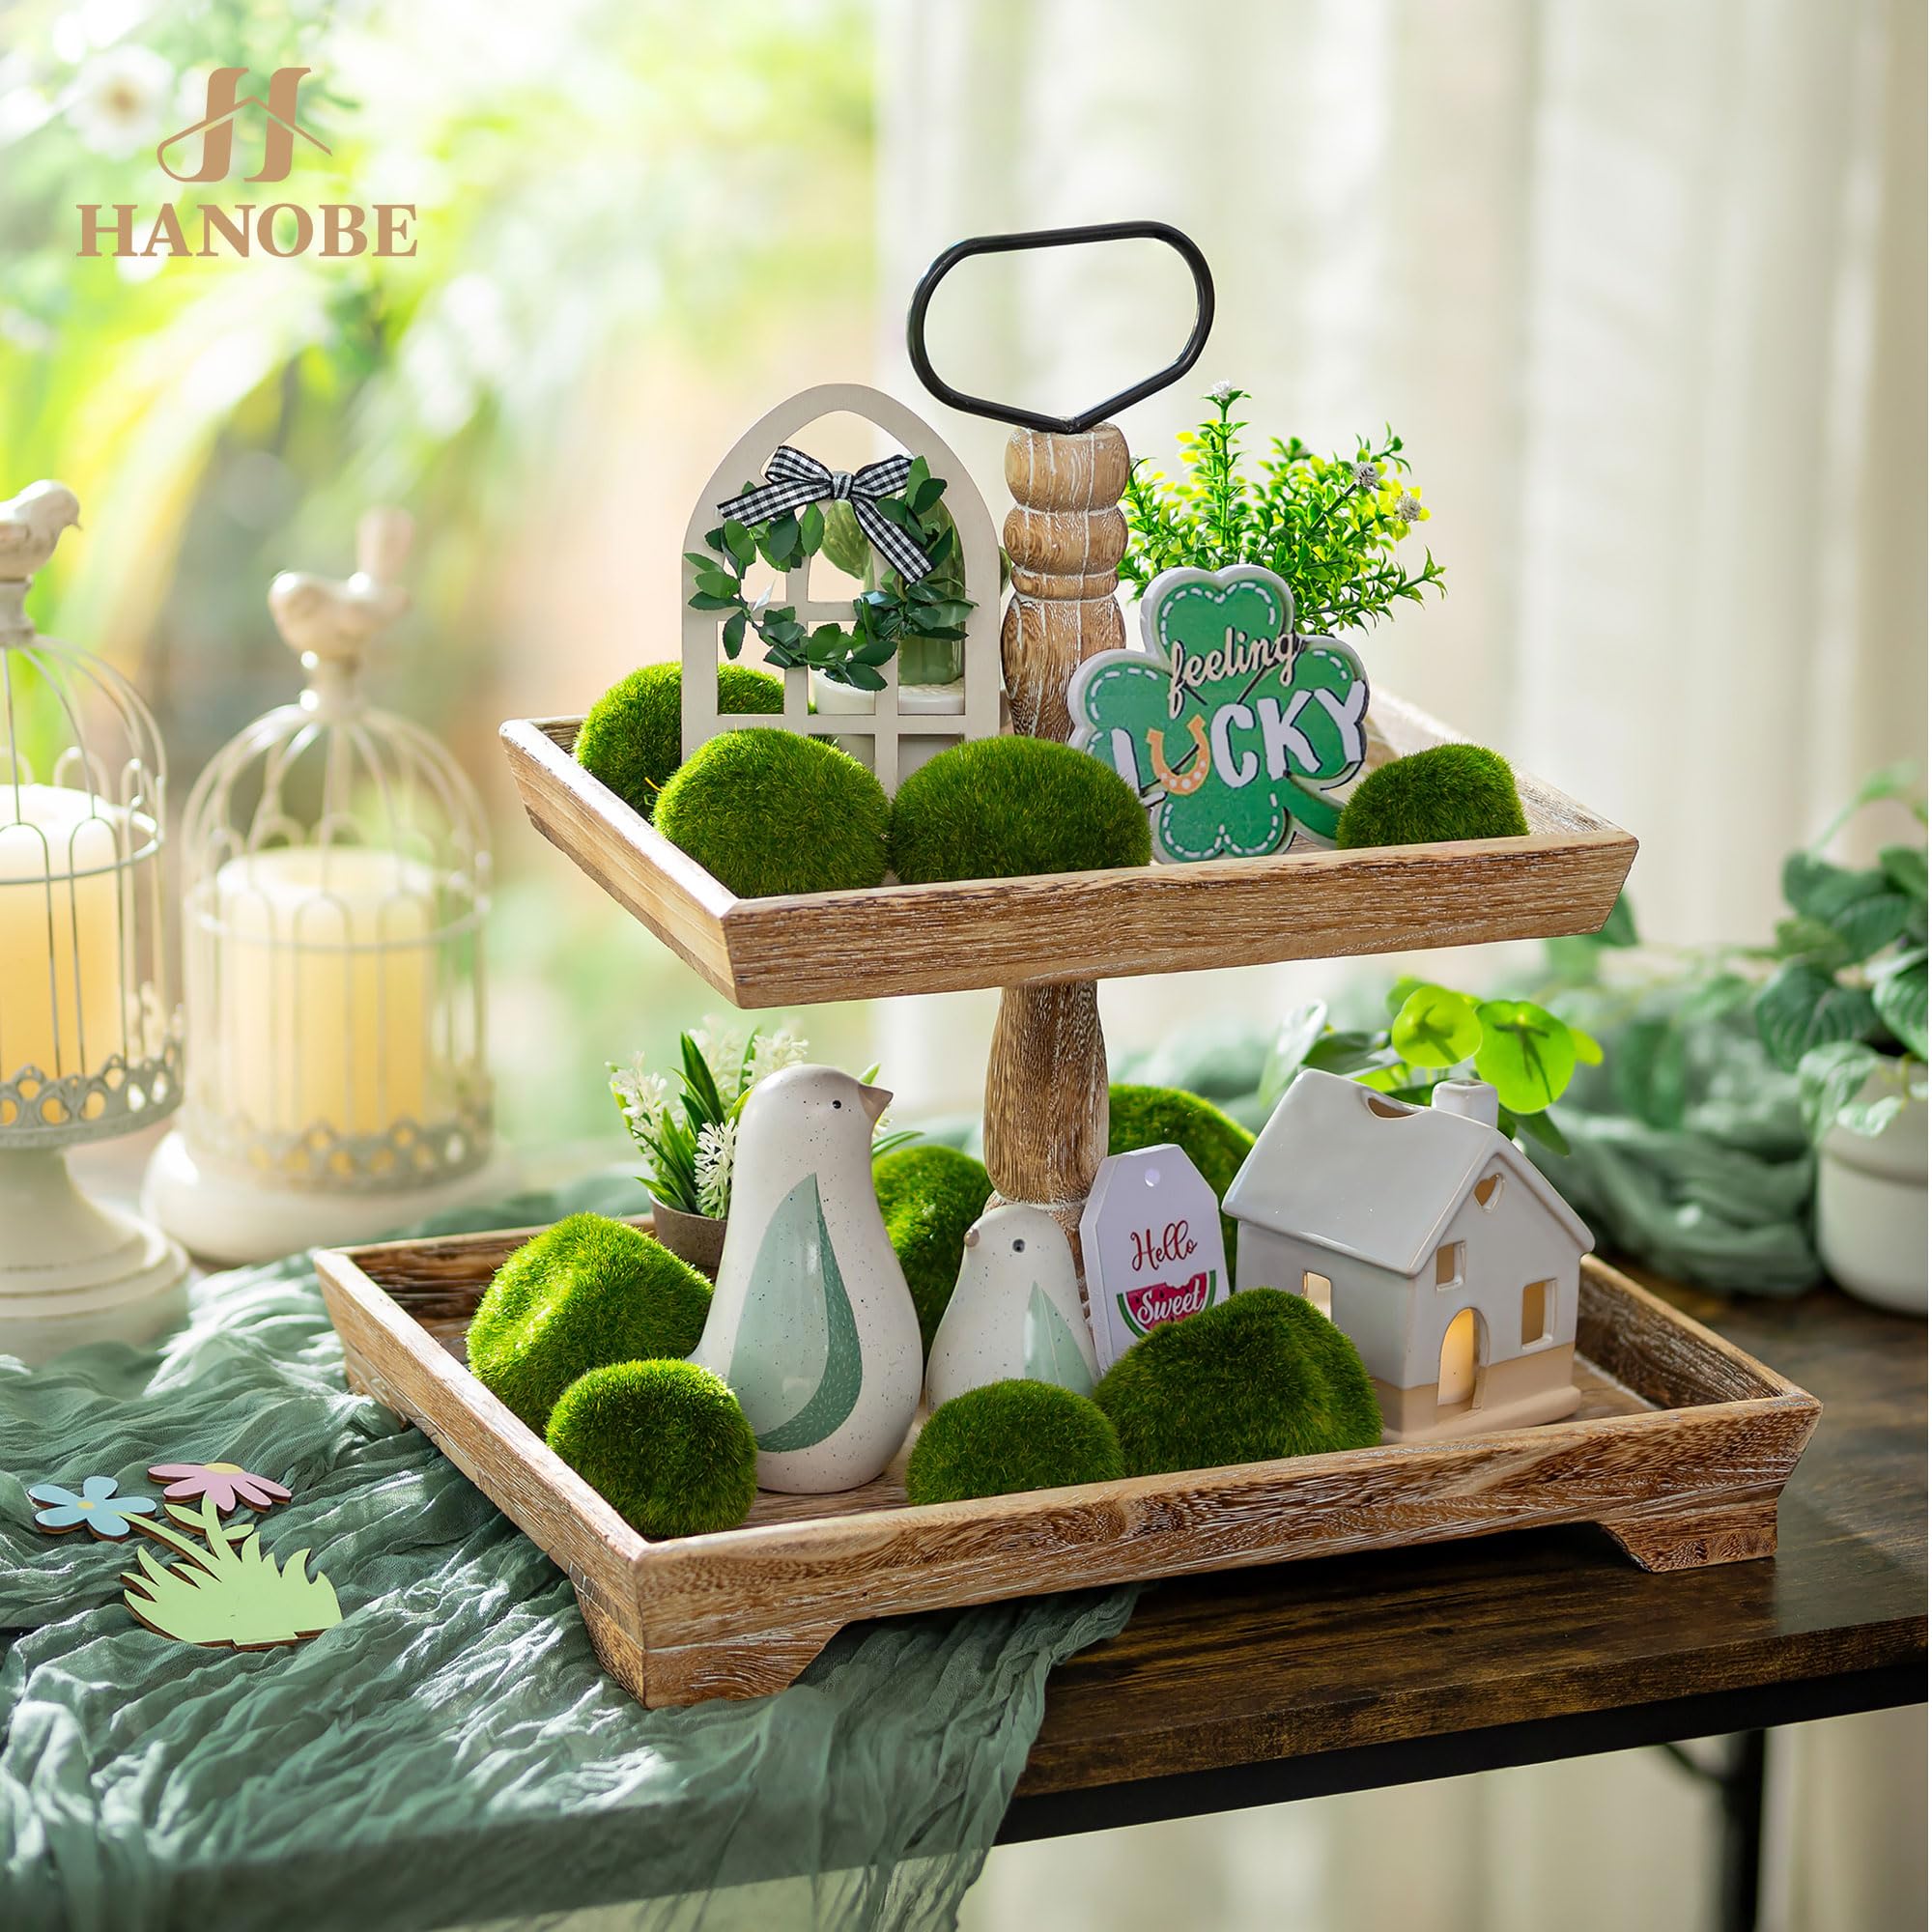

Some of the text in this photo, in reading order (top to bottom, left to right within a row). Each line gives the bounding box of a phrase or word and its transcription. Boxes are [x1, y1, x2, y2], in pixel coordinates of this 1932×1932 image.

[1168, 626, 1301, 720] feeling
[1110, 679, 1367, 808] LUCKY
[1129, 1219, 1198, 1271] Hello
[1136, 1277, 1204, 1325] Sweet
